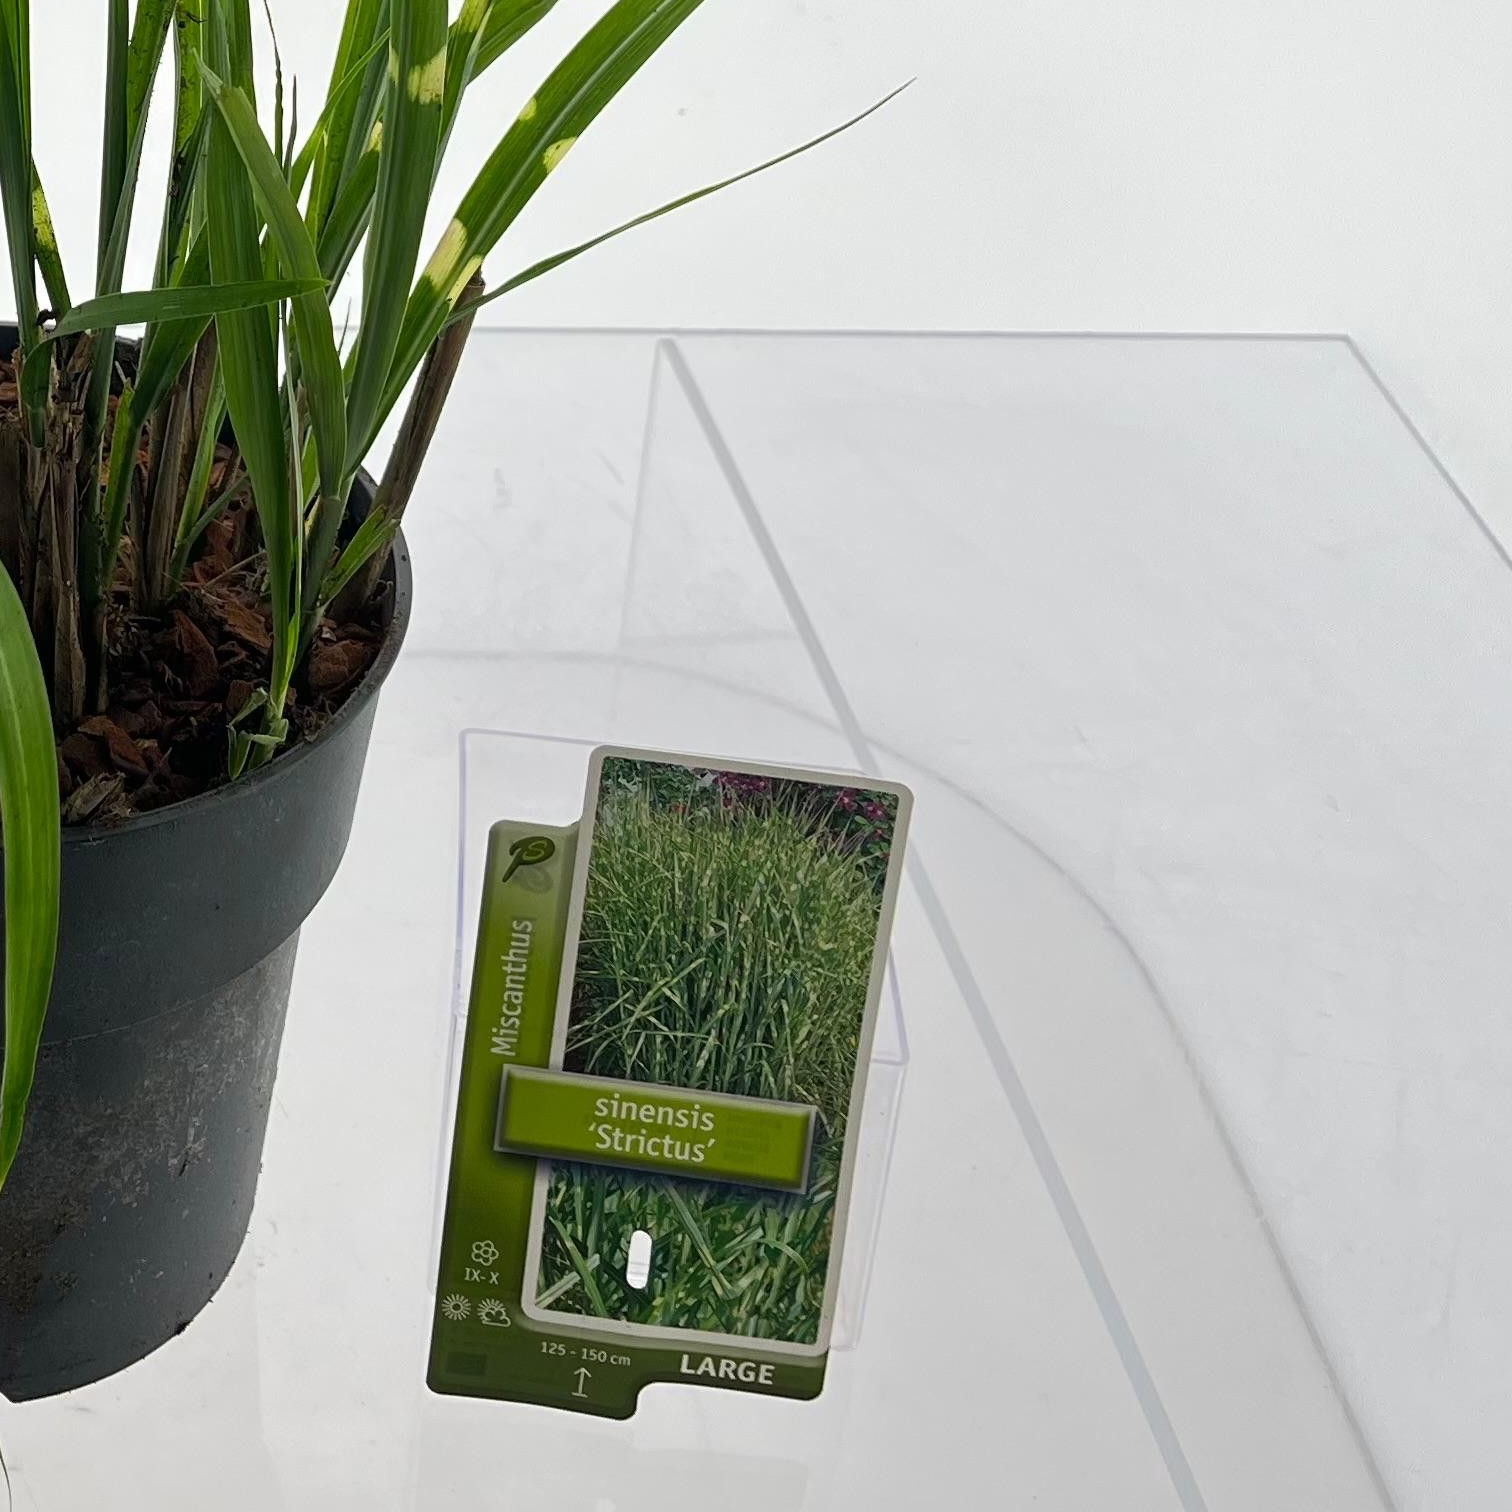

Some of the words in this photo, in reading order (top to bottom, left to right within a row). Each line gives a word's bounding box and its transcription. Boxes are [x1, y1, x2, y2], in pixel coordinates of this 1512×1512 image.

[490, 919, 533, 1057] Miscanthus
[594, 1093, 715, 1132] sinensis
[540, 1341, 566, 1357] 125
[581, 1347, 607, 1364] 150
[610, 1353, 632, 1367] cm
[680, 1353, 776, 1386] LARGE
